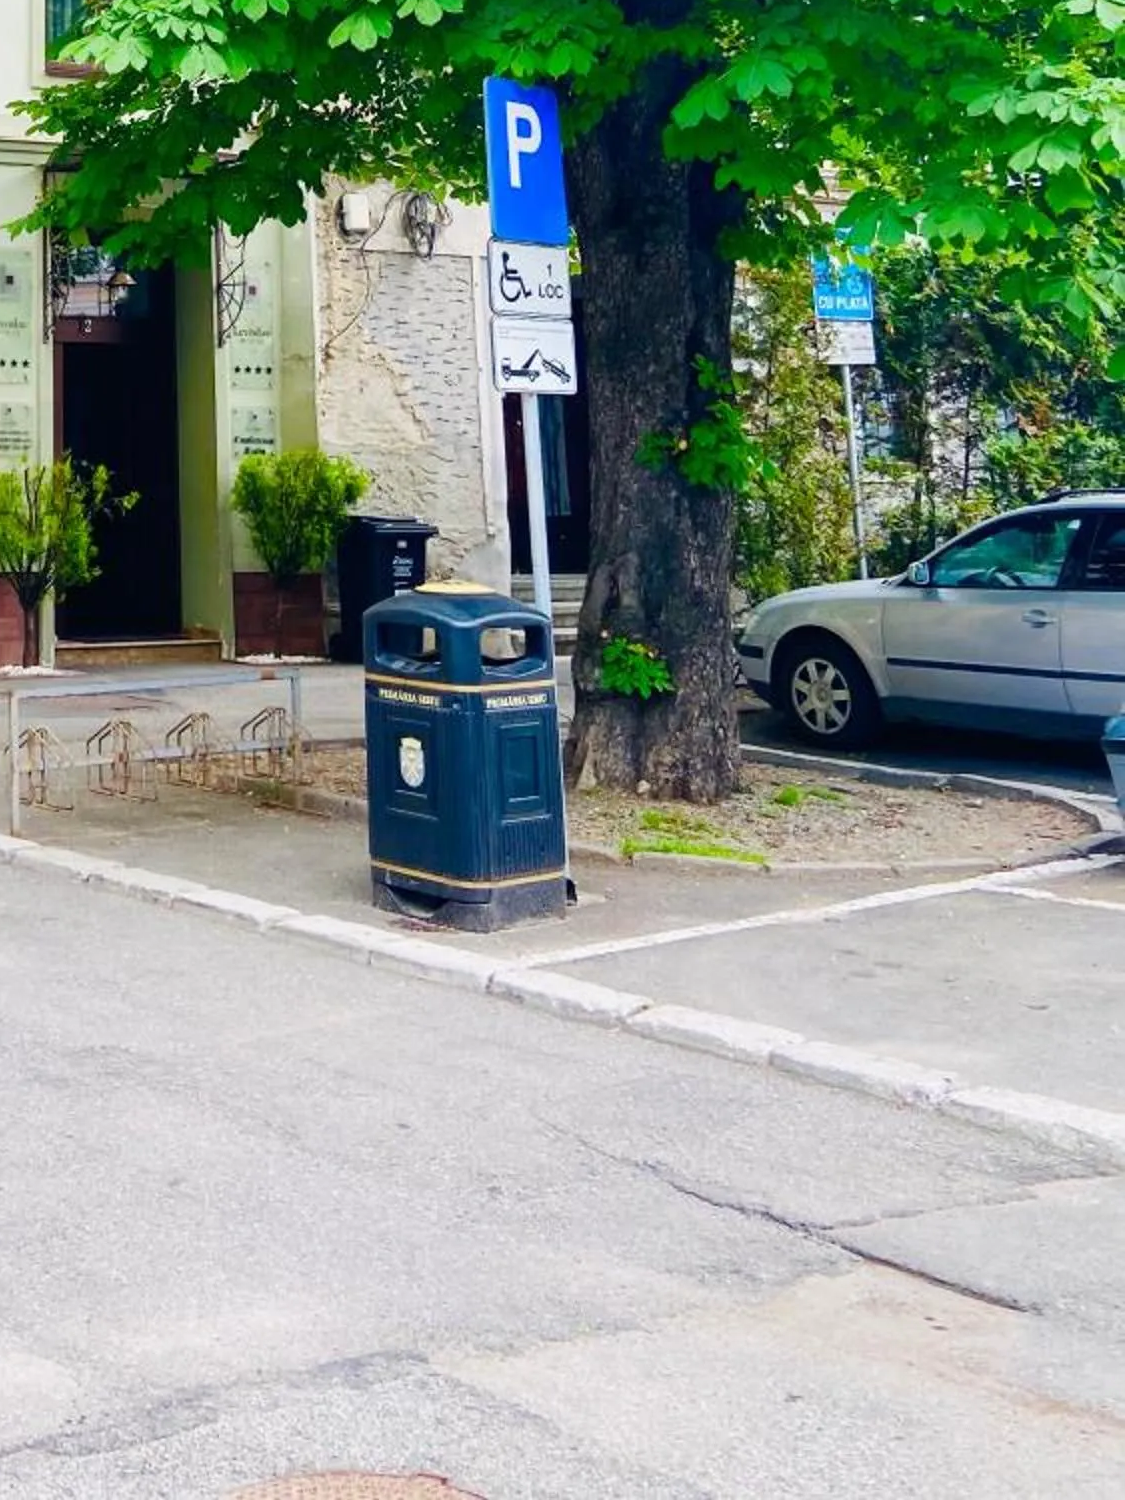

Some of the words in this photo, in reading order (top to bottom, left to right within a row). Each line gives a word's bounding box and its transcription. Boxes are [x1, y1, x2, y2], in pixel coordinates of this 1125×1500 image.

[506, 101, 542, 188] P
[546, 263, 553, 277] 1
[538, 283, 565, 299] LOC
[84, 319, 92, 333] 2
